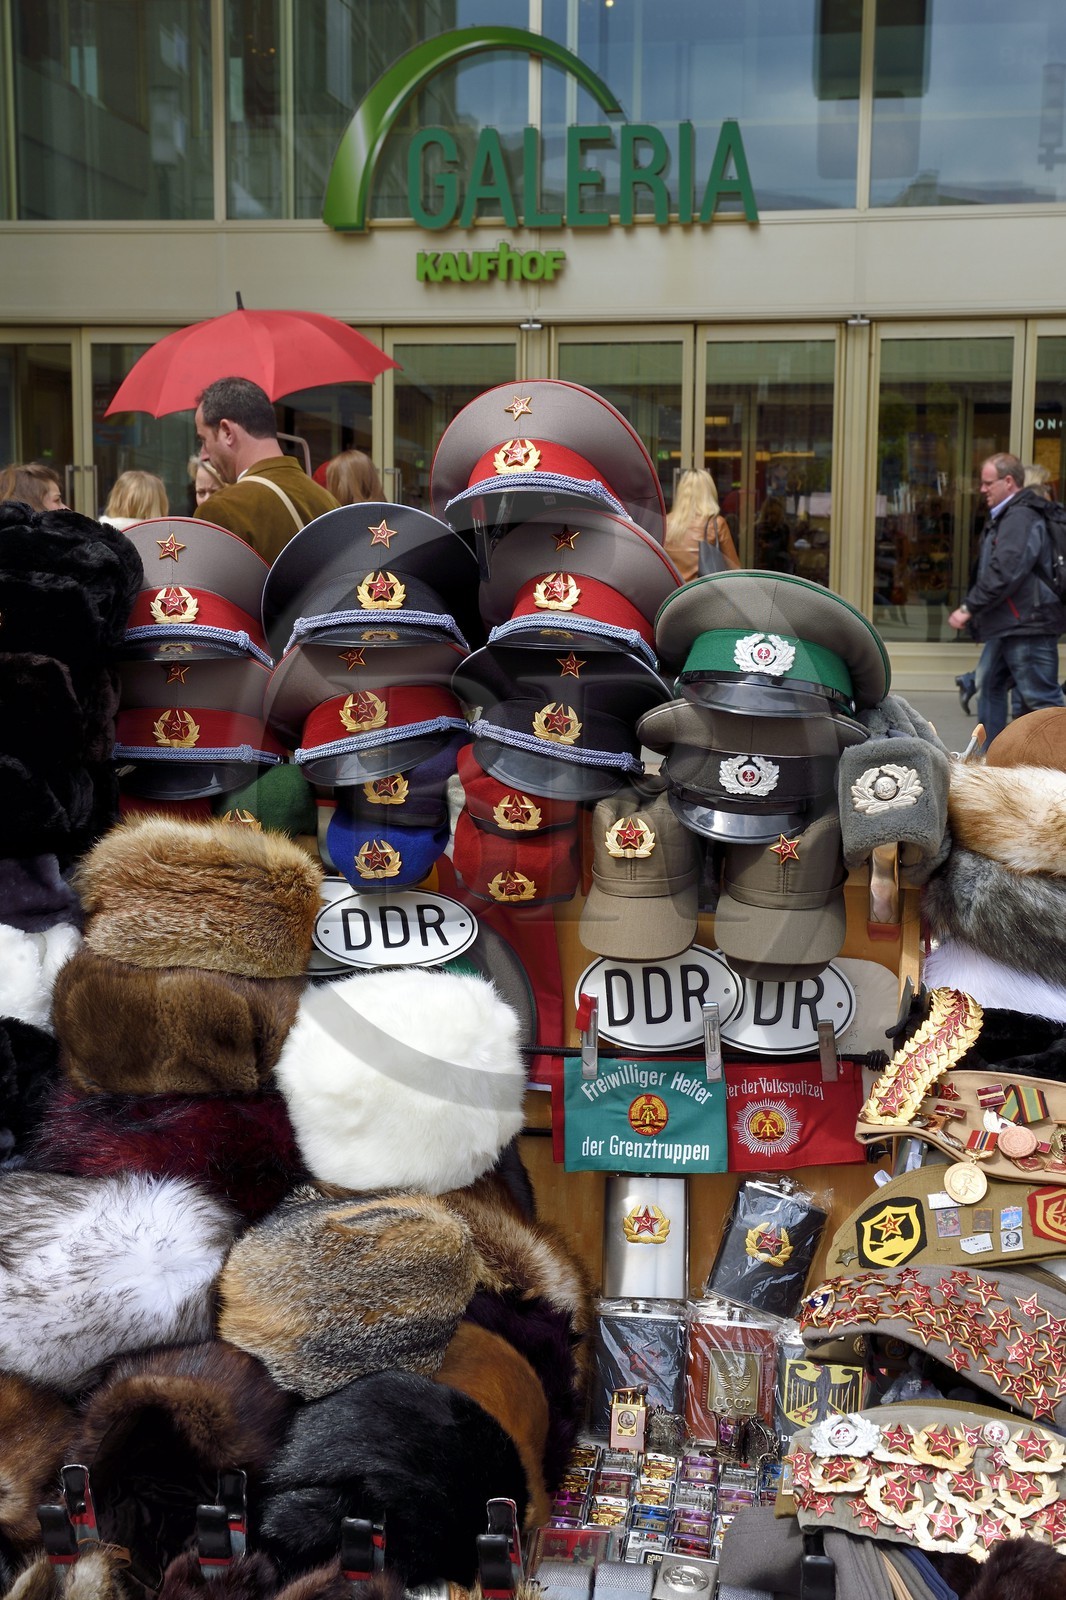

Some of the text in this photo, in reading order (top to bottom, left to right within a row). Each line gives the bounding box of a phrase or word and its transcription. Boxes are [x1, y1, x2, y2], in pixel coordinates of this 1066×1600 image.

[407, 119, 759, 230] GALERIA
[341, 904, 449, 951] DDR
[604, 964, 710, 1027] DDR
[734, 976, 825, 1032] DR
[581, 1064, 713, 1105] Freiwilliger Helfer
[741, 1079, 760, 1095] der
[758, 1077, 824, 1101] Volkspolizei
[582, 1135, 710, 1165] der Grenztruppen
[814, 1297, 824, 1306] 3
